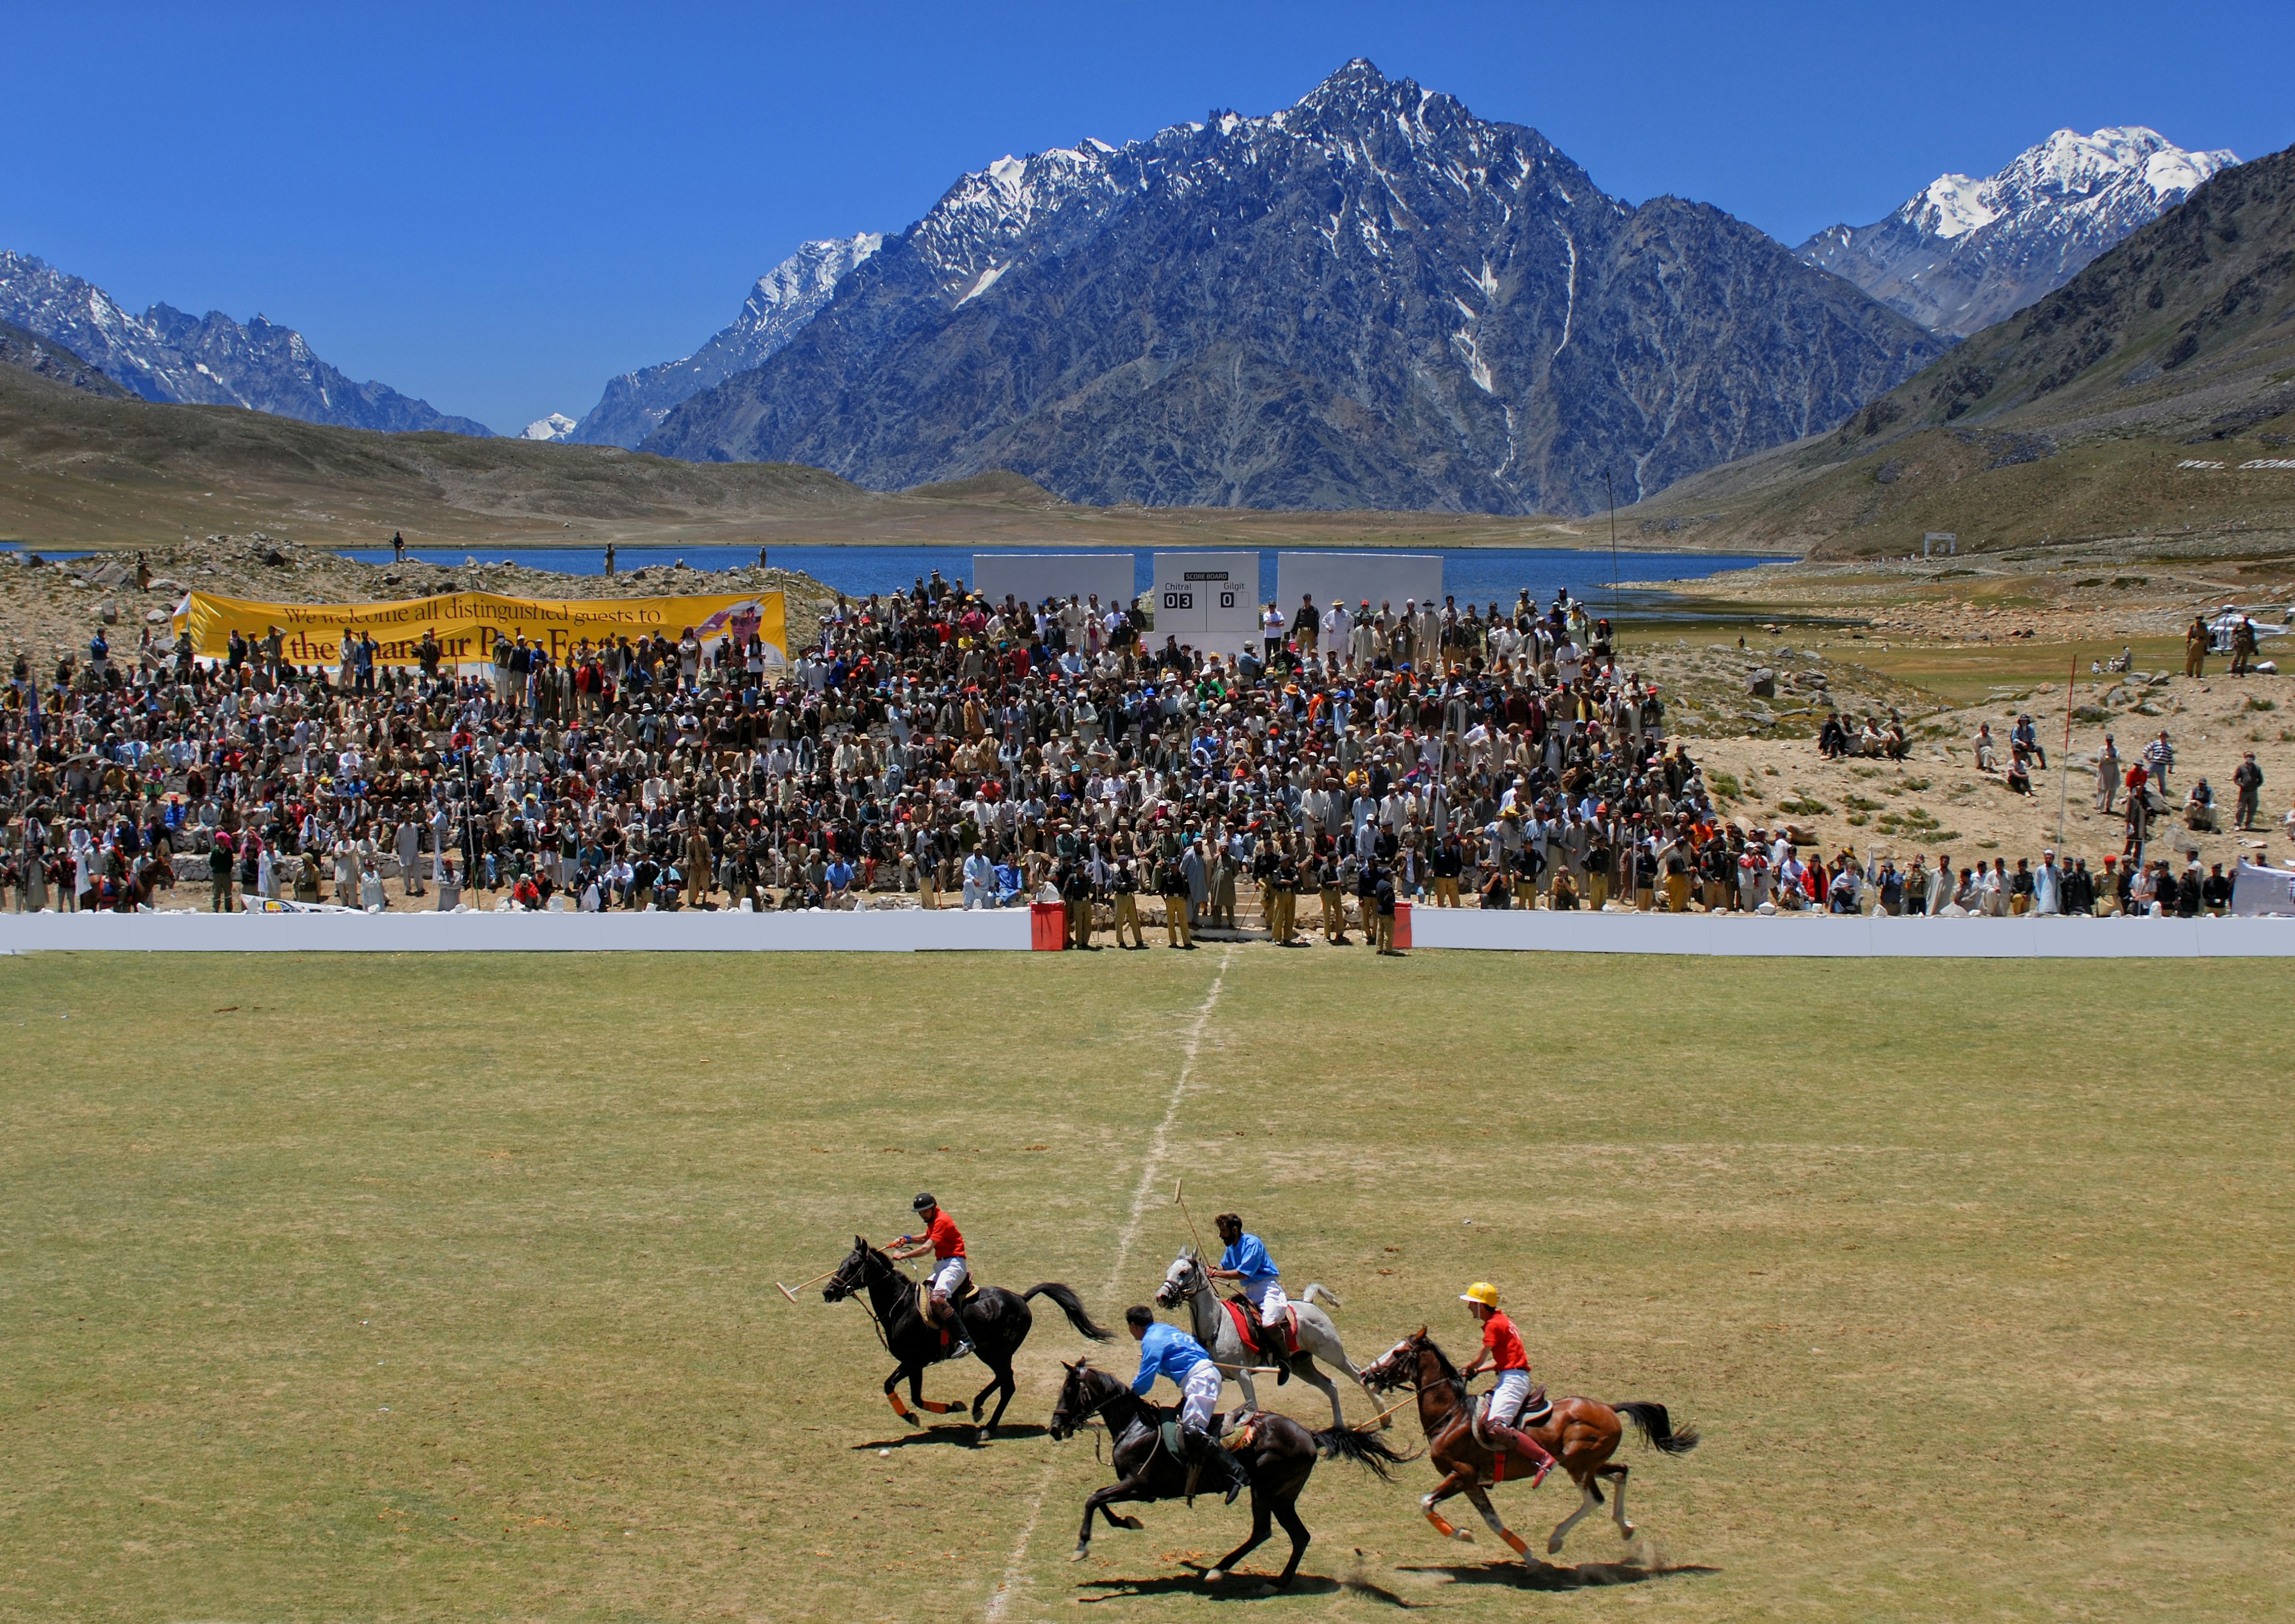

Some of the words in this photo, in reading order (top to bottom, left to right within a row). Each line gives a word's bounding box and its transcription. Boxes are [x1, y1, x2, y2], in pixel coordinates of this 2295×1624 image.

[1165, 583, 1192, 591] Chitral
[1223, 582, 1244, 591] Gilgit
[1223, 594, 1232, 606] 0
[284, 608, 316, 624] We
[322, 608, 408, 624] welcome
[415, 601, 439, 621] all
[445, 597, 568, 624] distinguished
[574, 609, 634, 626] guests
[639, 609, 660, 623] to
[289, 630, 336, 660] the
